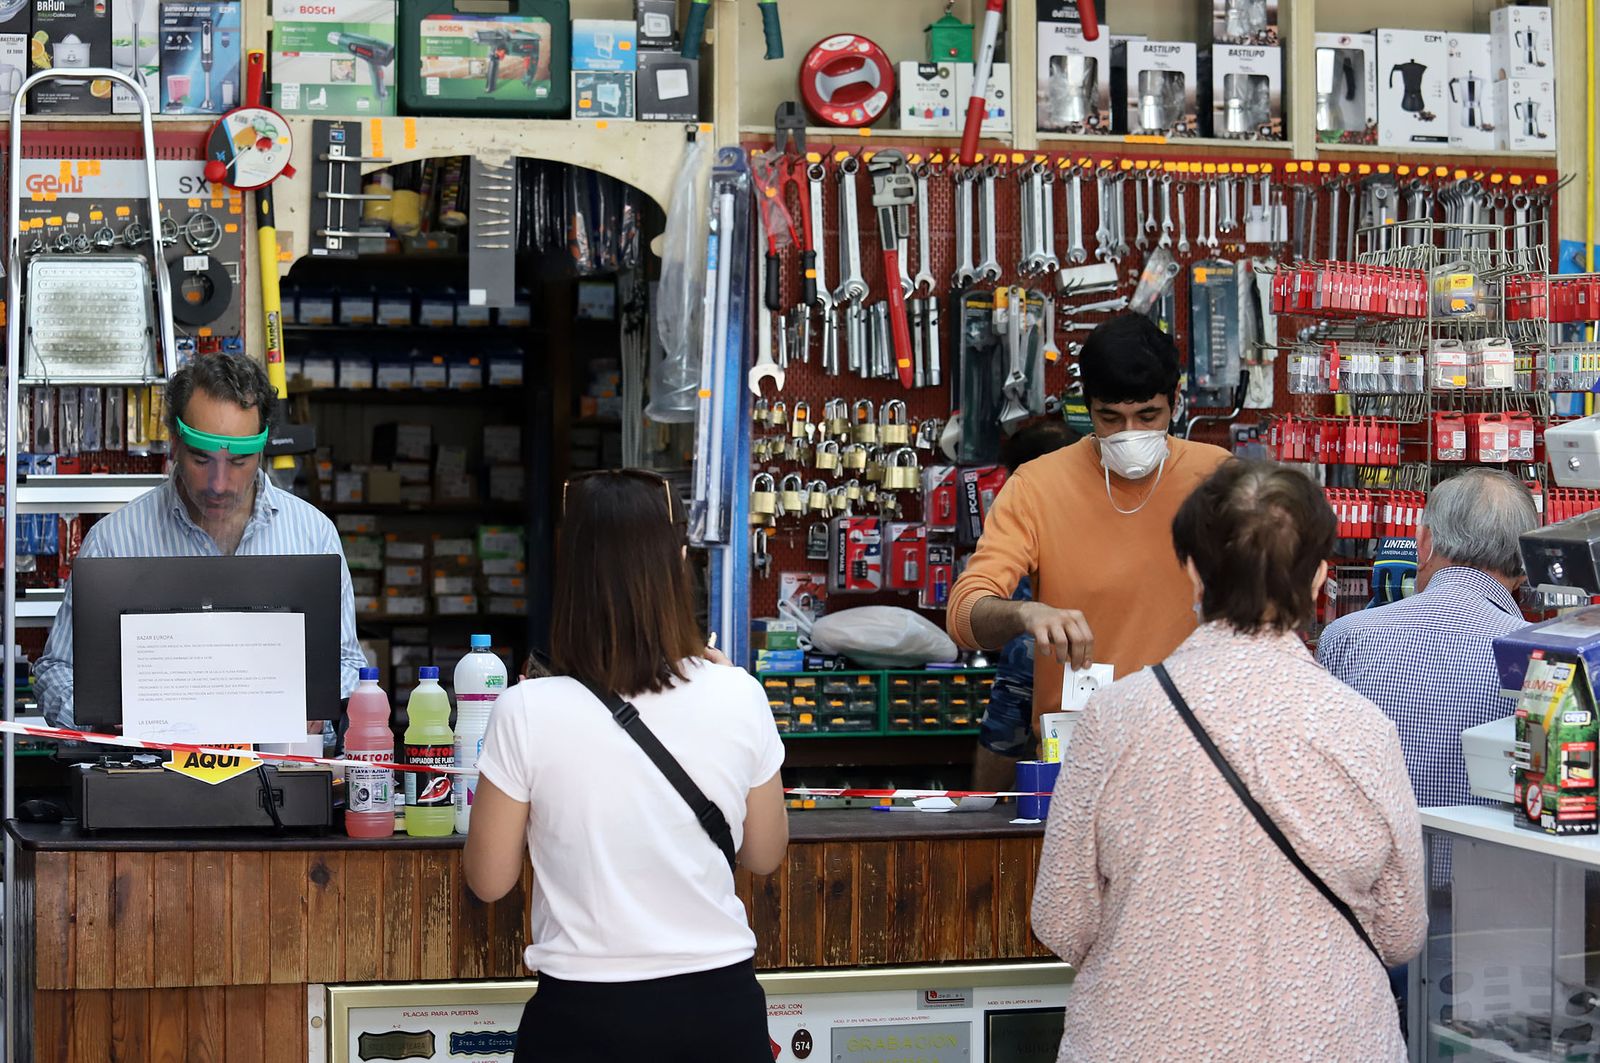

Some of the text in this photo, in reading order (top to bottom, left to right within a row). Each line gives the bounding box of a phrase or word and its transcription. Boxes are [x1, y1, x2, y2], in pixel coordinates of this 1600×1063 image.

[37, 0, 65, 11] BRAUN
[300, 6, 336, 14] BOSCH
[1143, 45, 1181, 54] BASTILIPO
[1228, 49, 1265, 58] BASTILIPO
[179, 176, 210, 194] SX
[967, 482, 978, 514] PC410
[1384, 540, 1418, 549] LINTERN
[795, 1041, 811, 1051] 574
